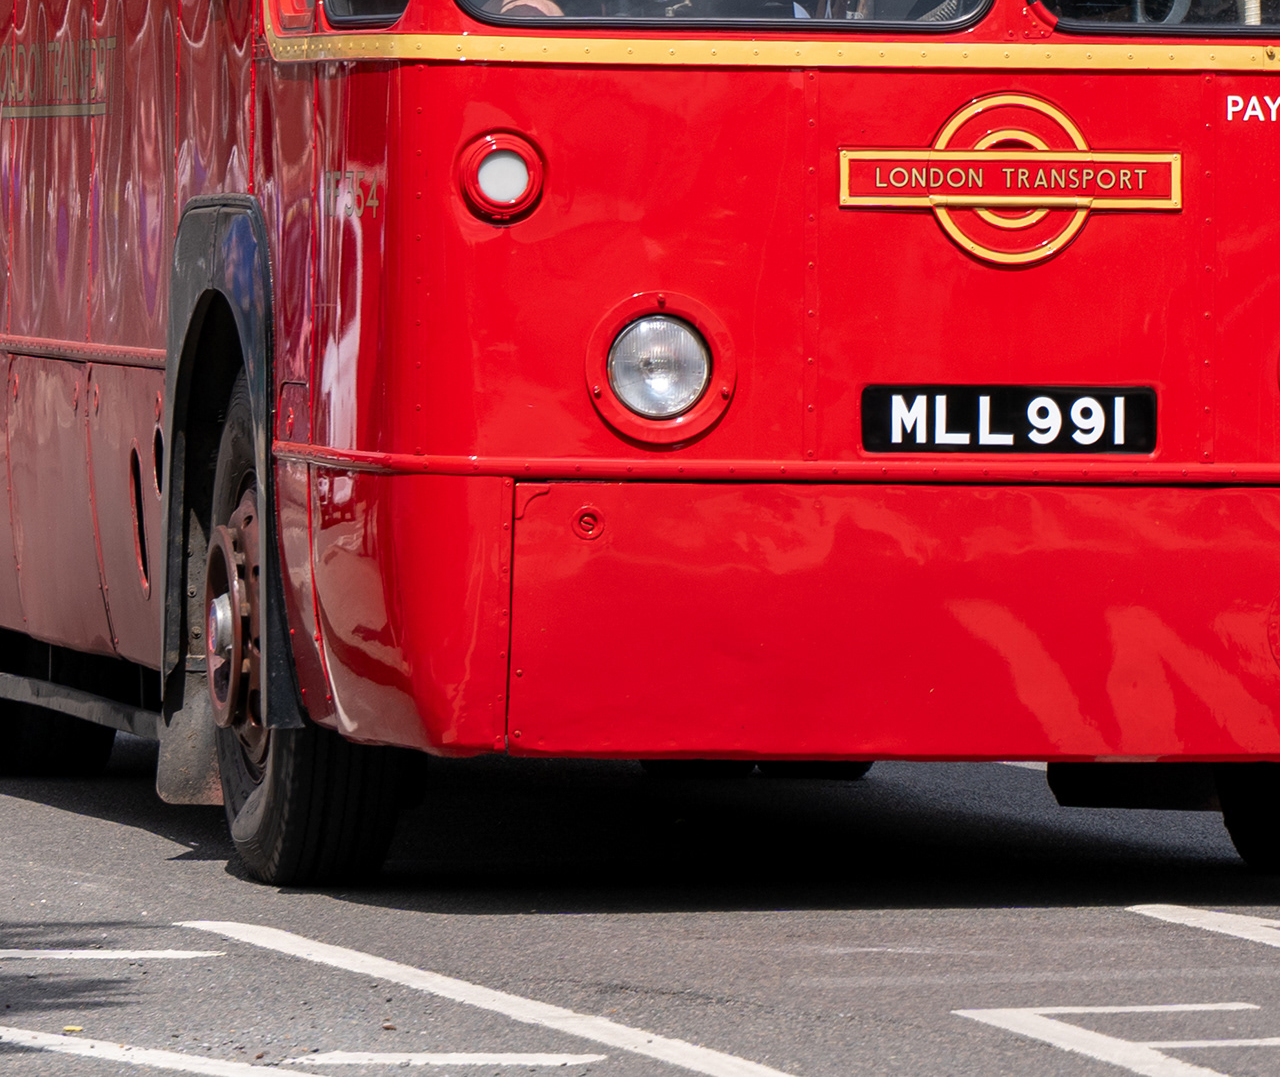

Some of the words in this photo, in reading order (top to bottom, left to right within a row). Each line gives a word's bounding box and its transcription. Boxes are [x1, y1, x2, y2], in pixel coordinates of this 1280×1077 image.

[325, 170, 341, 218] RF
[344, 170, 380, 219] 354
[875, 166, 984, 189] LONDON
[1002, 167, 1148, 190] TRANSPORT
